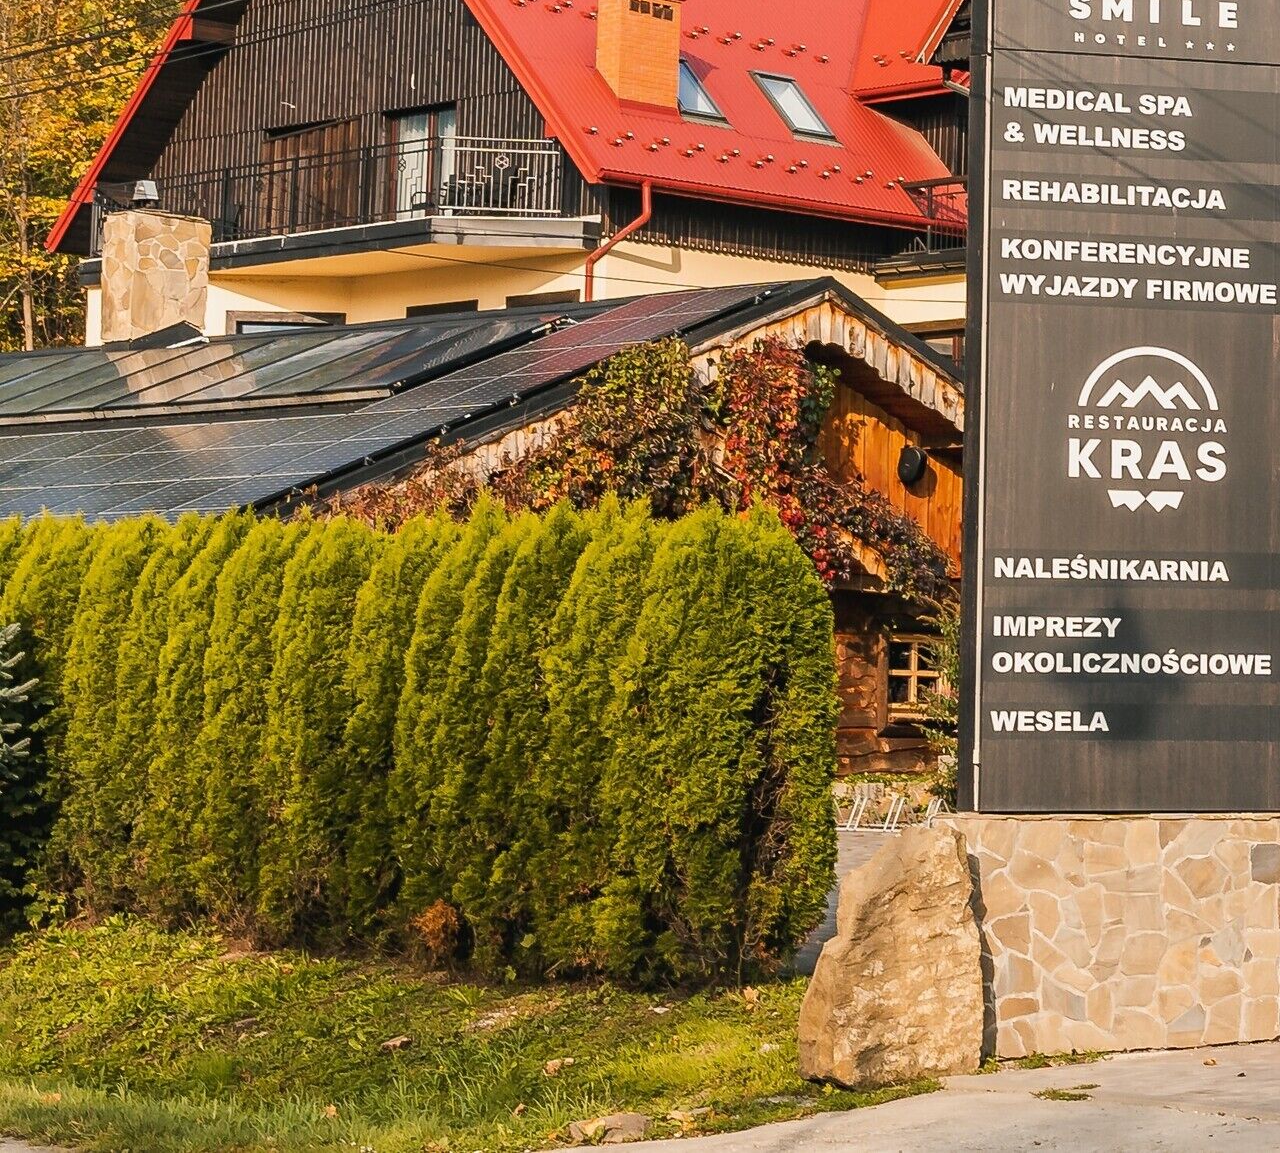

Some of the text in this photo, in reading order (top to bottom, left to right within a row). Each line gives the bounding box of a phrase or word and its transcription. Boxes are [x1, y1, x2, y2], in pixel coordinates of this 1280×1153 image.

[1075, 32, 1166, 47] HOTEL
[1004, 87, 1192, 116] MEDICAL SPA
[1004, 122, 1185, 150] & WELLNESS
[1003, 180, 1226, 210] REHABILITACJA
[1002, 239, 1249, 268] KONFERENCYJNE
[1000, 274, 1276, 304] WYJAZDY FIRMOWE
[1069, 415, 1227, 432] RESTAURACJA
[1069, 438, 1226, 481] KRAS
[995, 554, 1229, 581] NALEŚNIKARNIA
[994, 616, 1121, 637] IMPREZY
[992, 649, 1271, 674] OKOLICZNOŚCIOWE
[991, 711, 1109, 731] WESELA
